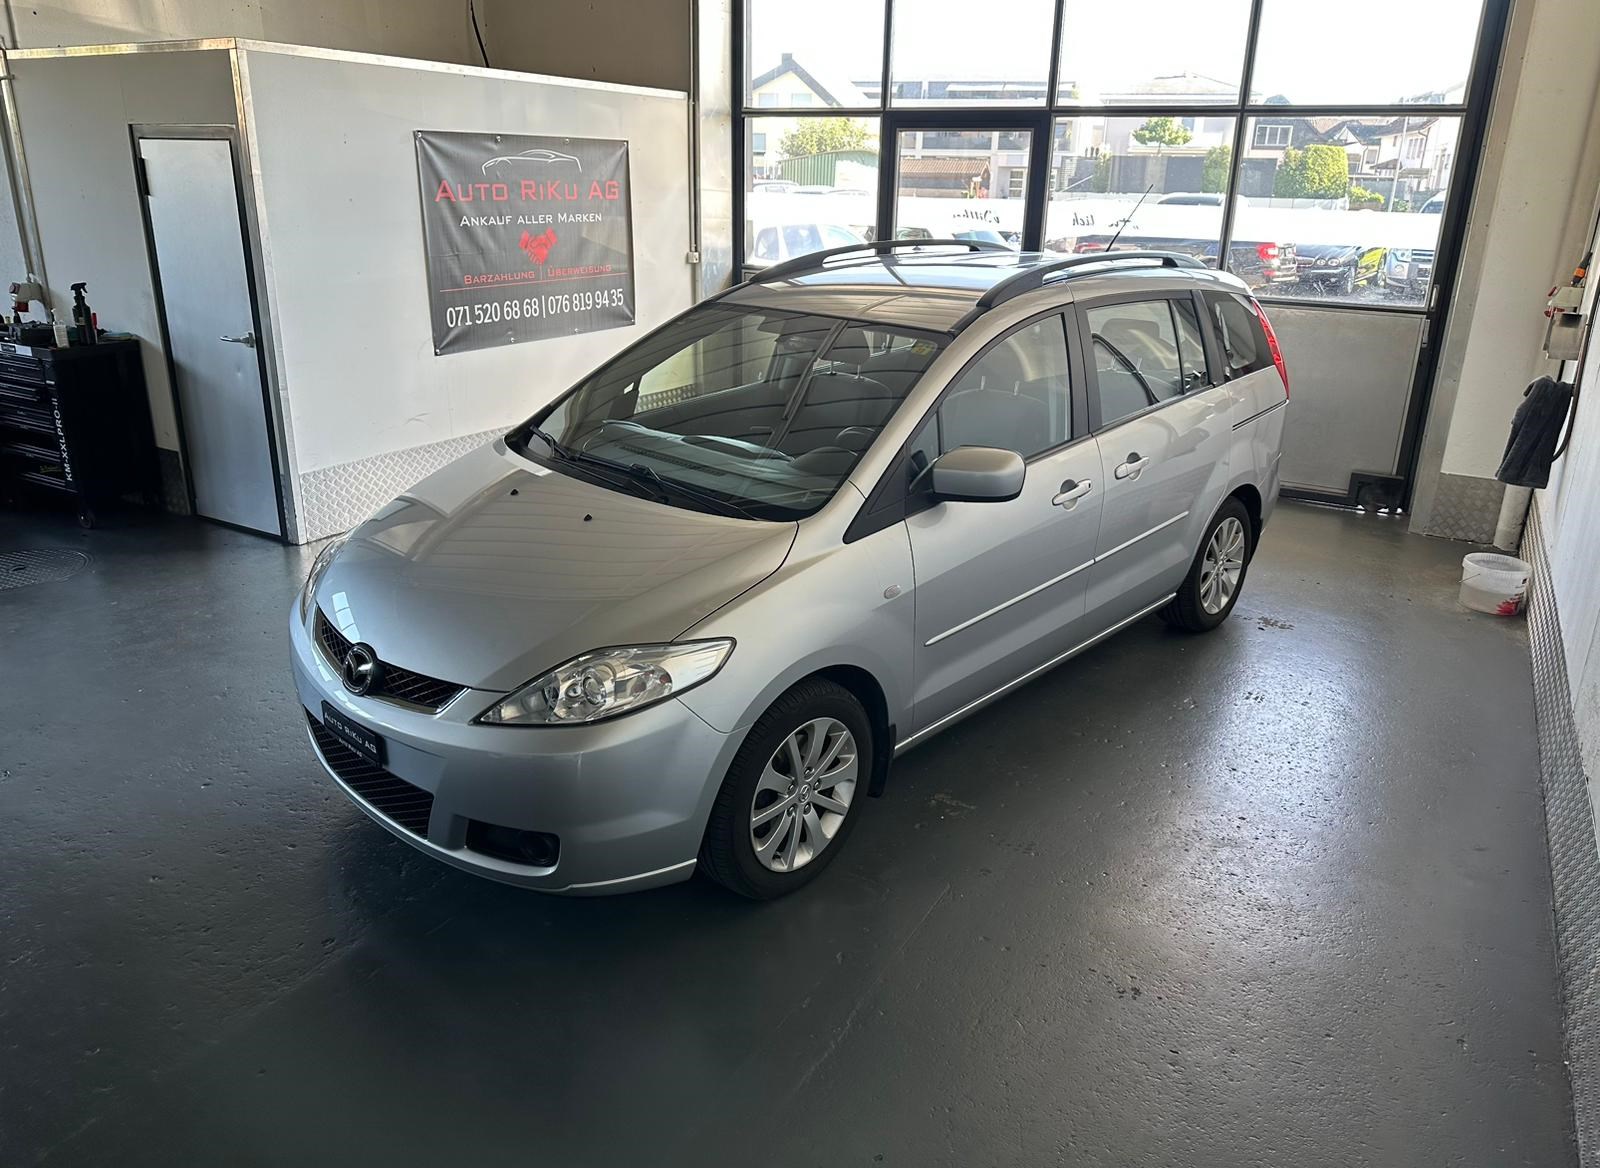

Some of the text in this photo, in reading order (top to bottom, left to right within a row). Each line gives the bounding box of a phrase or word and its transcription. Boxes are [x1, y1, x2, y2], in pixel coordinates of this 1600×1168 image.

[588, 180, 620, 200] AG
[459, 212, 602, 227] ANKAUF ALLER MARKEN
[463, 271, 536, 285] BARZAHLUNG
[446, 288, 625, 328] 071 520 68 68 076 819 94 35
